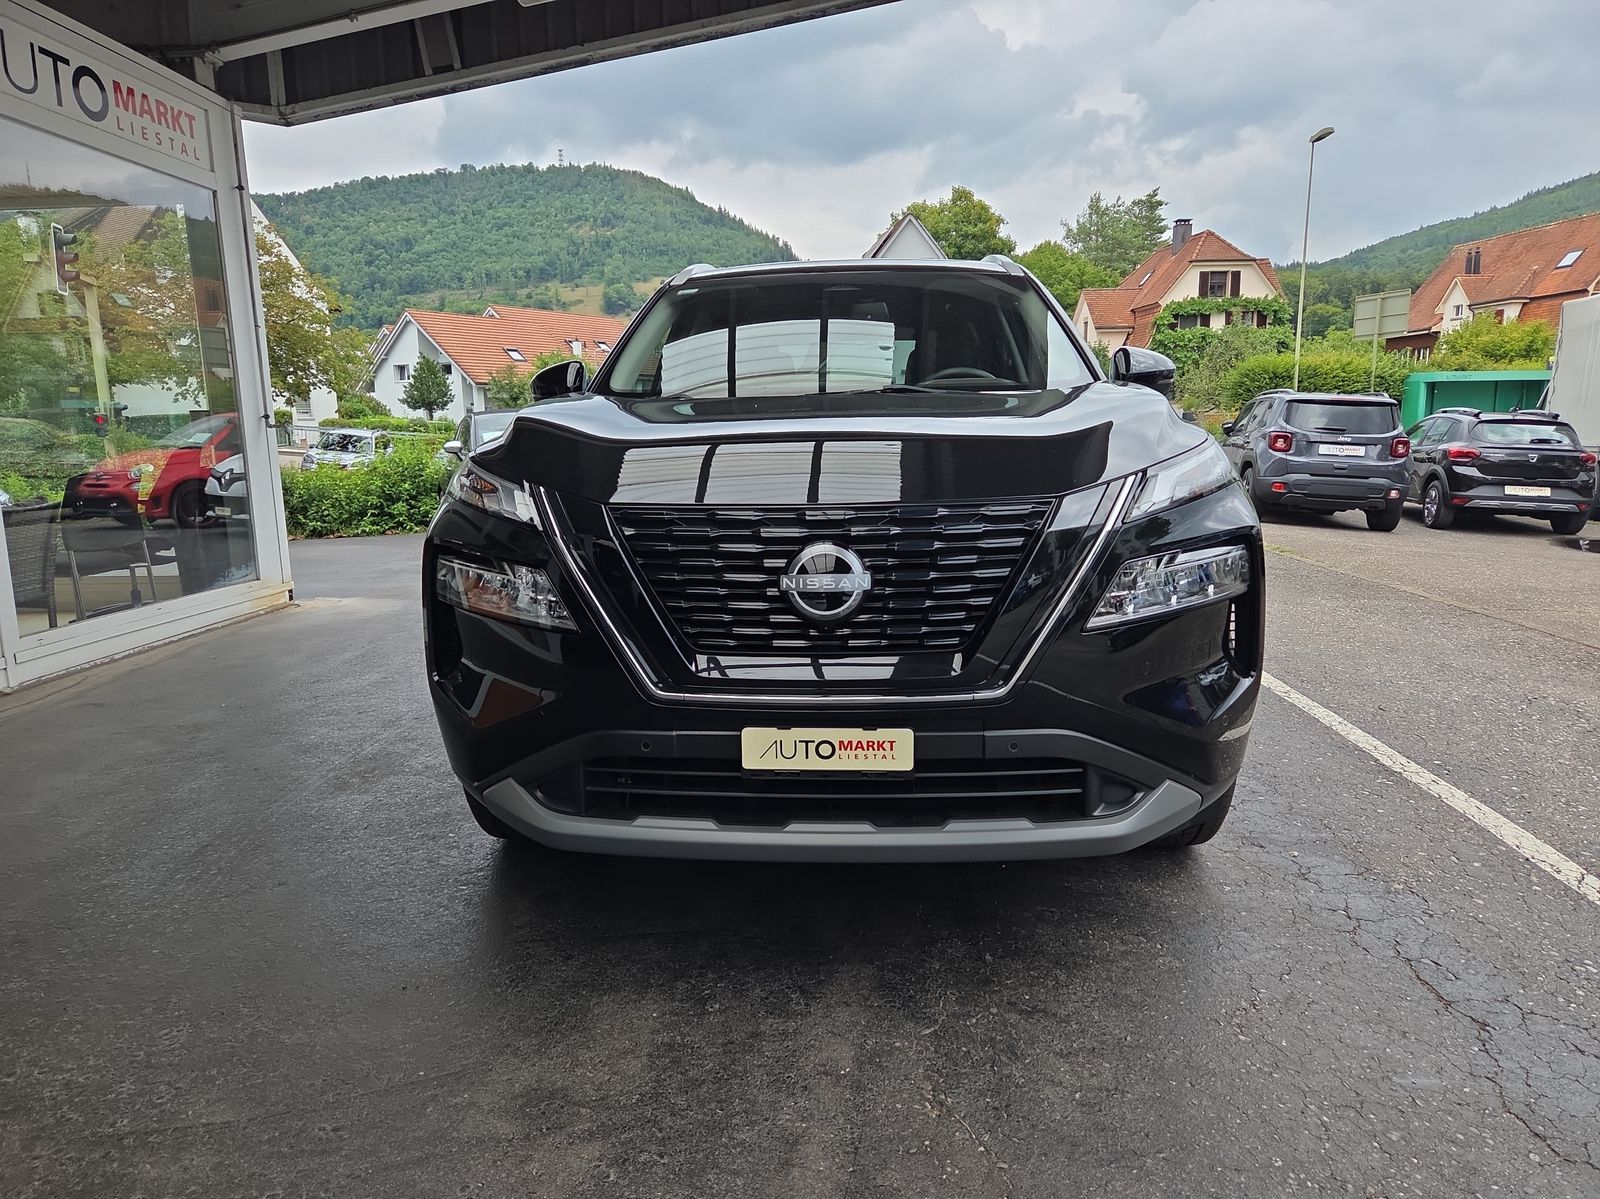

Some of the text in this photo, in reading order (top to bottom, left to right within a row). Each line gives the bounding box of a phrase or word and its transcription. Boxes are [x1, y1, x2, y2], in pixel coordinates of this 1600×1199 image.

[0, 28, 196, 140] UTO MARKT
[116, 116, 201, 161] LIESTAL
[782, 577, 868, 589] NISSAN
[838, 740, 897, 752] MARKT
